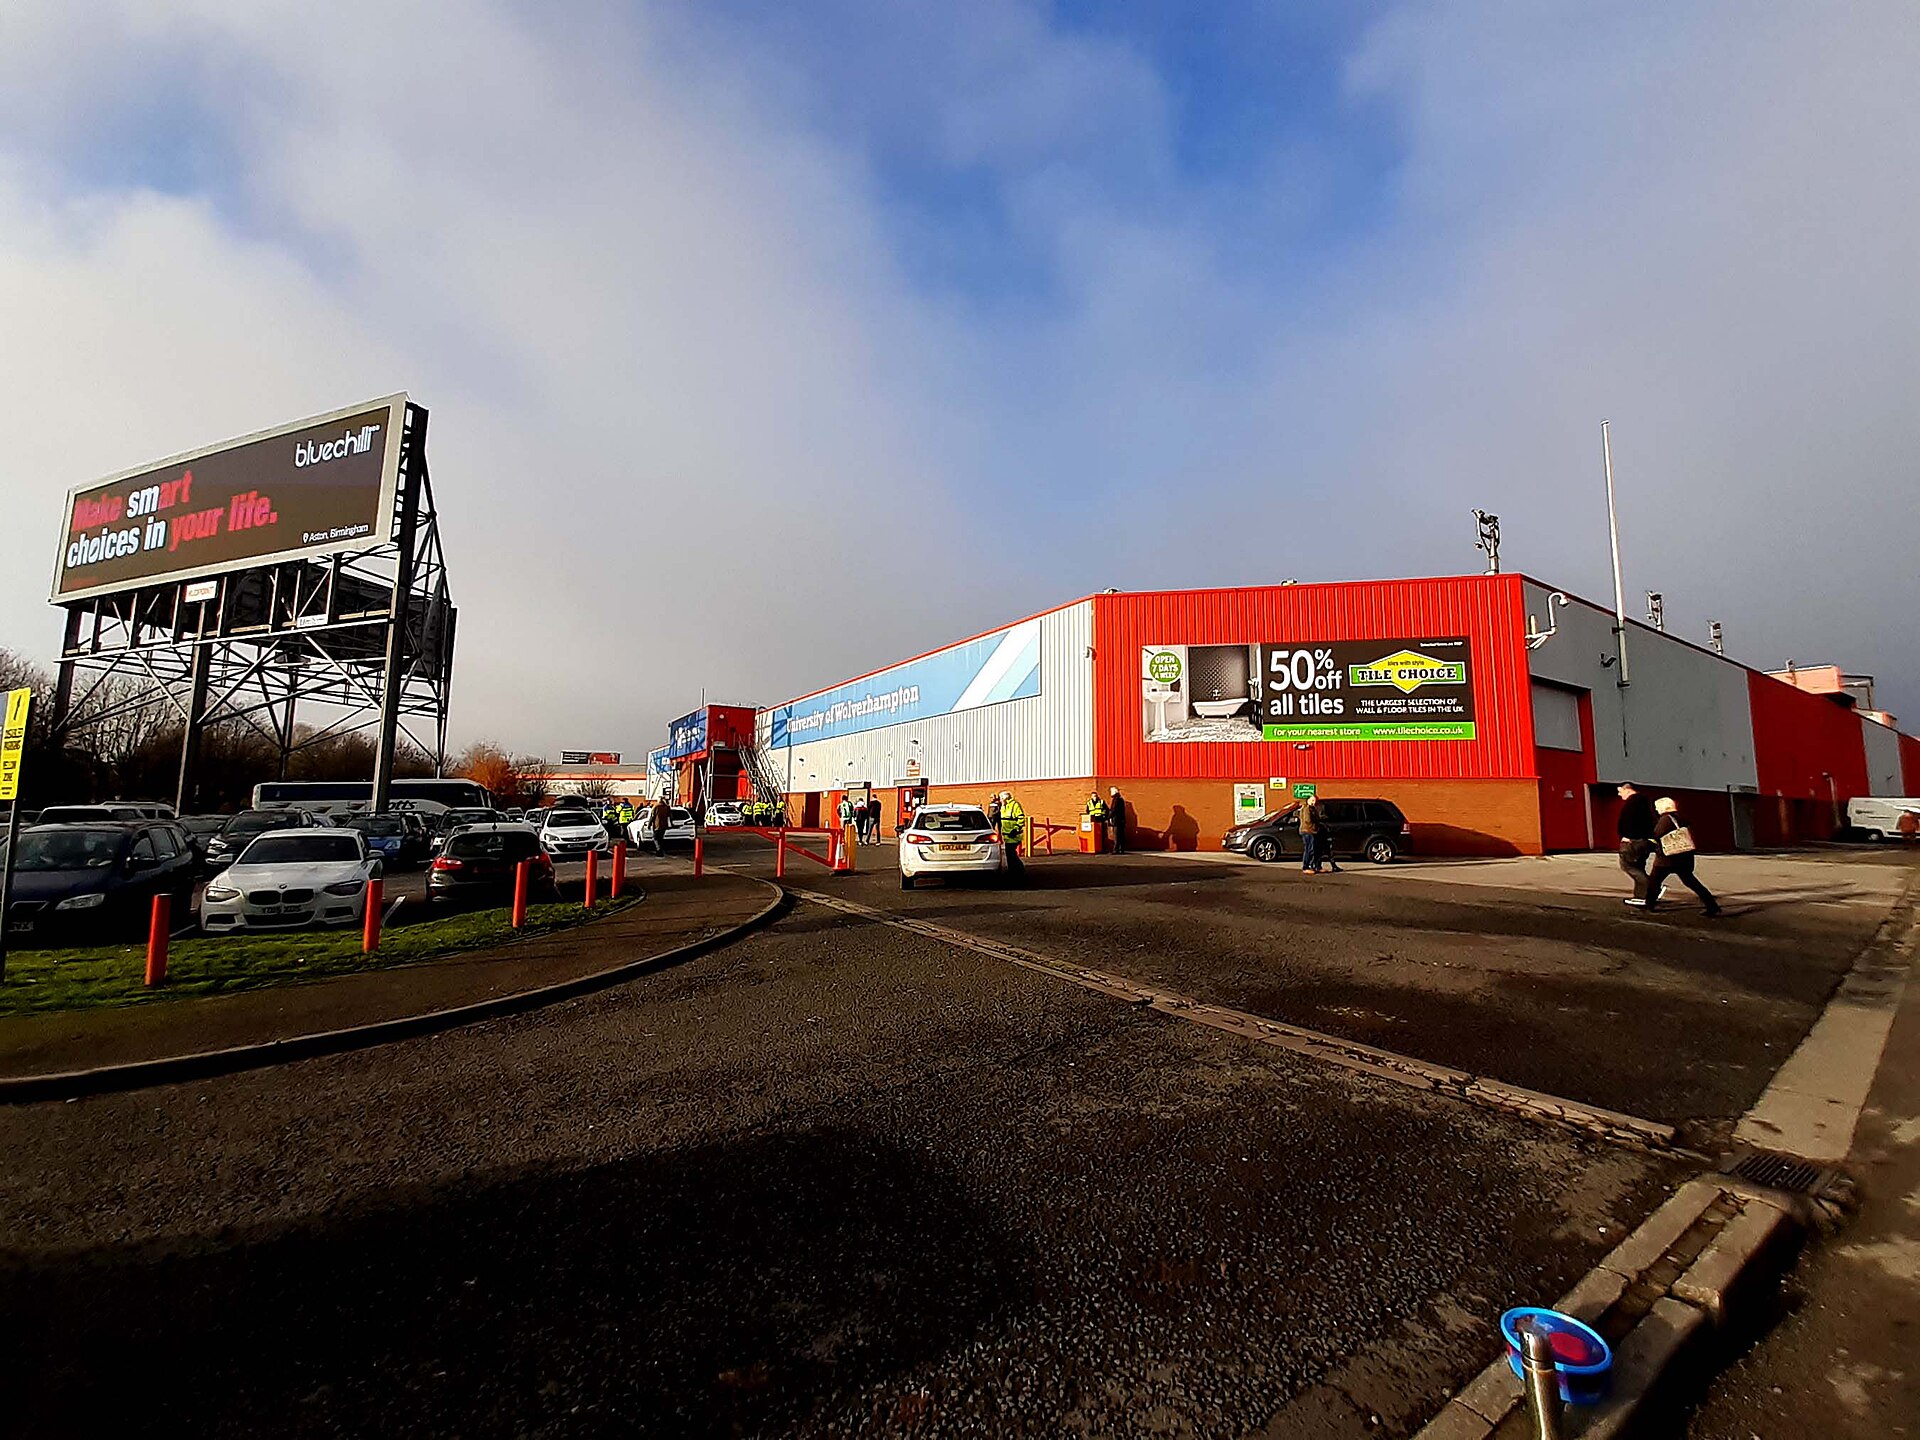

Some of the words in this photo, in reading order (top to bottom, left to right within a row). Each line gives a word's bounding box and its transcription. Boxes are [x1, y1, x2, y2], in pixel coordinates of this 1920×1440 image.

[127, 470, 193, 518] smart
[66, 527, 140, 568] choices
[143, 516, 167, 550] in
[168, 507, 224, 552] your
[227, 490, 278, 532] life.
[330, 525, 369, 537] Birmingham
[1154, 655, 1176, 664] OPEN
[1158, 664, 1179, 672] DAYS
[1358, 669, 1392, 681] TILE
[1398, 668, 1456, 680] CHOICE
[1314, 670, 1342, 690] off
[1270, 693, 1294, 715] all
[1299, 693, 1344, 715] tiles
[1407, 698, 1445, 706] SELECTION
[786, 709, 824, 733] University
[825, 704, 835, 724] of
[834, 685, 919, 721] Wolverhampton
[1273, 728, 1287, 736] for
[1287, 729, 1306, 738] your
[1307, 728, 1339, 736] nearest
[1339, 728, 1361, 736] store
[1372, 726, 1464, 735] www.tilechoice.co.uk
